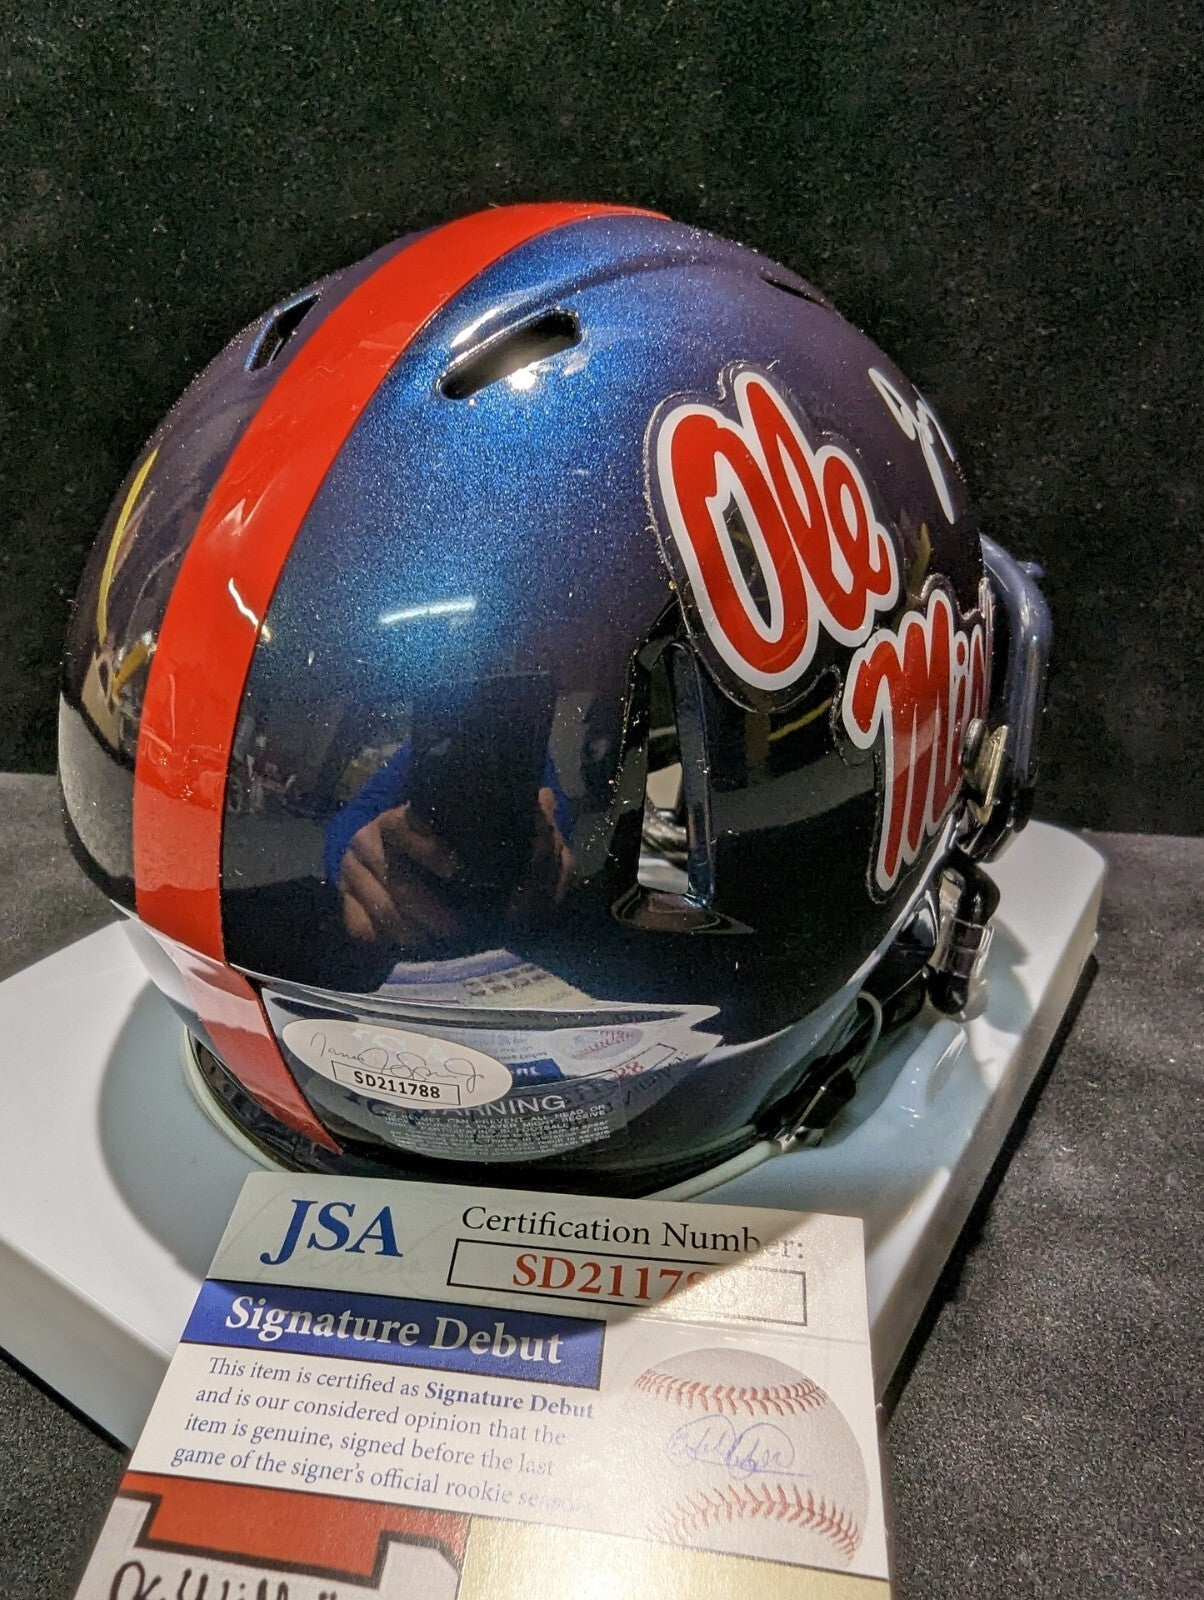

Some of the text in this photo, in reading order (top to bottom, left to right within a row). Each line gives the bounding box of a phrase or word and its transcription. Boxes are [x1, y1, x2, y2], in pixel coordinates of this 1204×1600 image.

[657, 372, 899, 690] Ole
[843, 589, 986, 891] Mi
[354, 1071, 441, 1099] SD211788
[260, 1199, 403, 1266] JSA
[461, 1205, 804, 1260] Certification Number:
[225, 1295, 564, 1365] Signature Debut
[195, 1387, 567, 1445] and is our considered opinion that the
[208, 1357, 595, 1419] This item is certified as Signature Debut
[184, 1413, 555, 1476] item is genuine, signed before the last
[170, 1447, 226, 1468] game
[230, 1449, 255, 1470] of
[255, 1452, 287, 1474] the
[291, 1458, 364, 1484] signer’s
[370, 1466, 440, 1494] official
[445, 1479, 513, 1505] rookie
